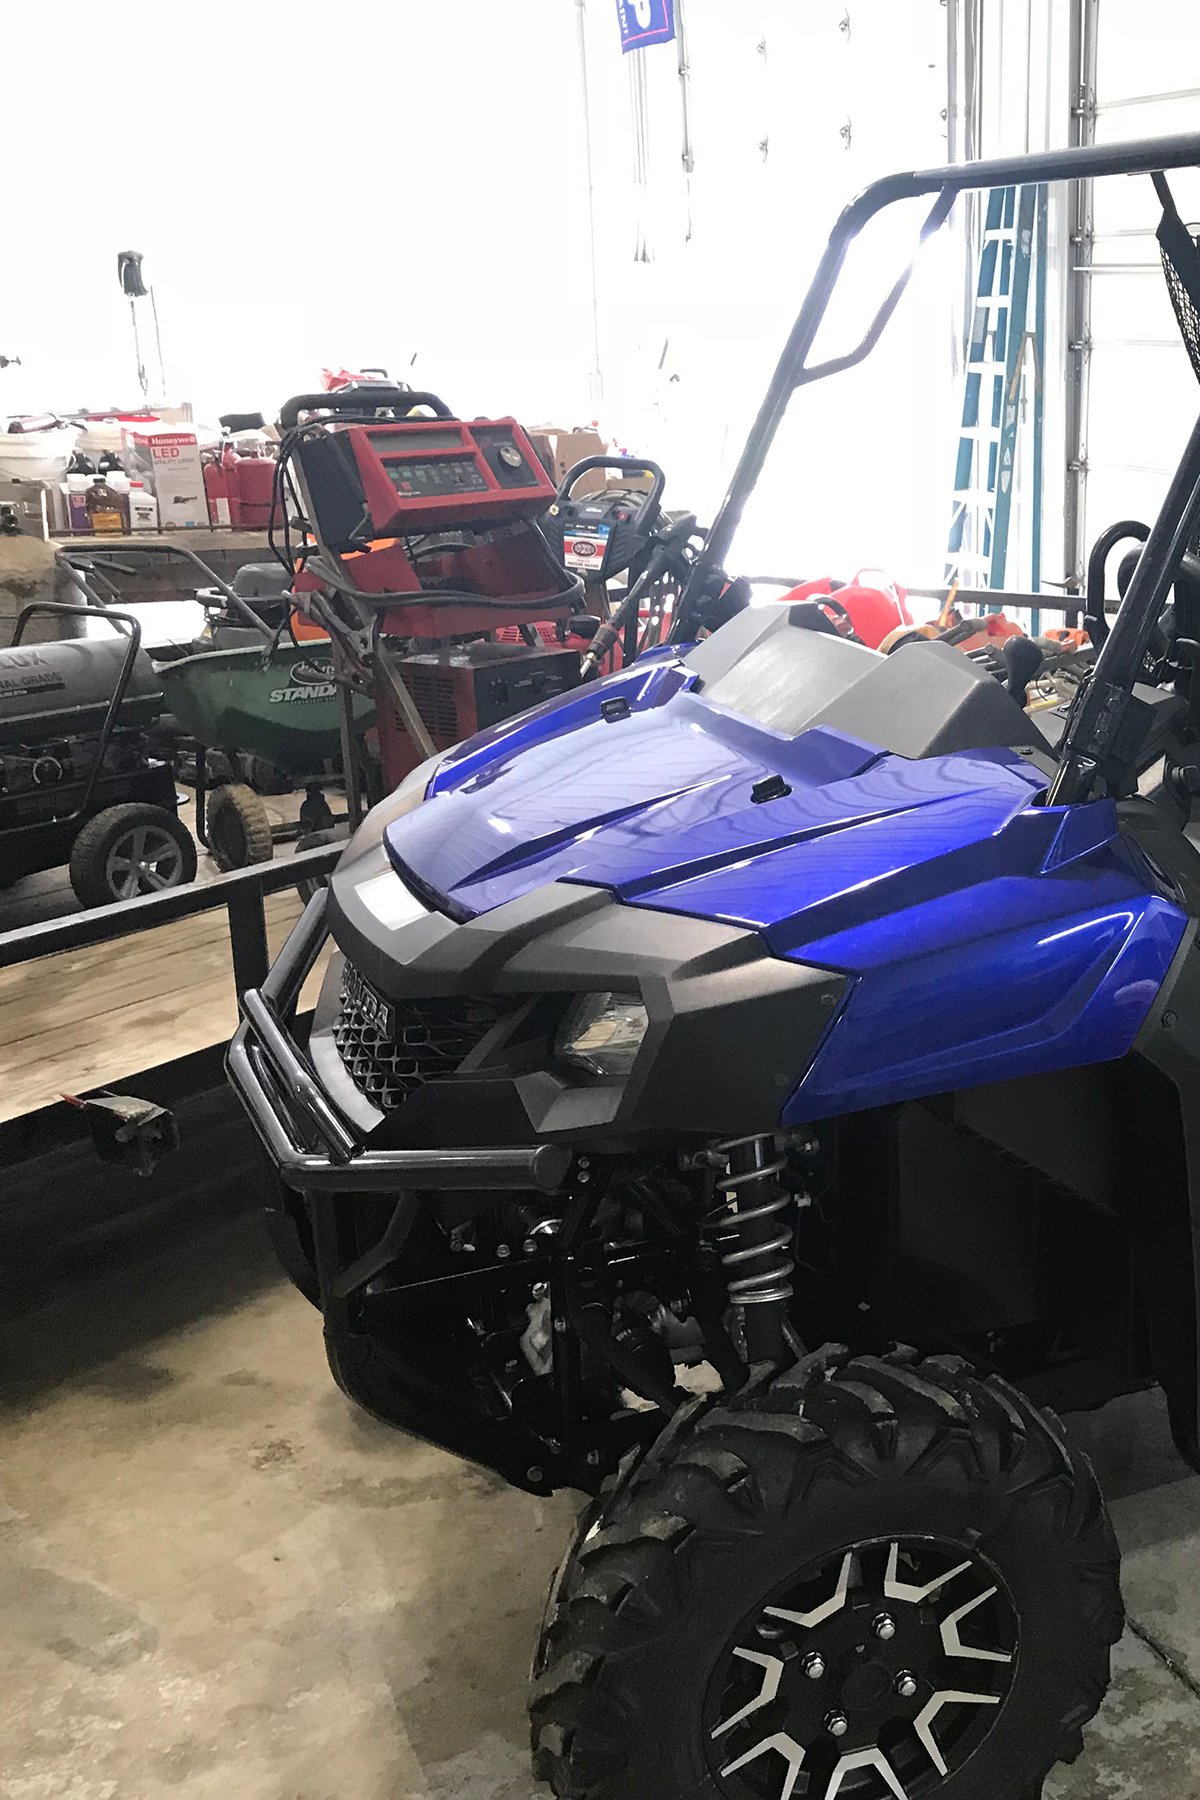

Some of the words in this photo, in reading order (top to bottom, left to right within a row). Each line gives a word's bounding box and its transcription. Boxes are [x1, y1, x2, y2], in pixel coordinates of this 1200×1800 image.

[151, 436, 197, 446] Honeywell
[152, 447, 180, 459] LED
[22, 671, 63, 687] GRADE
